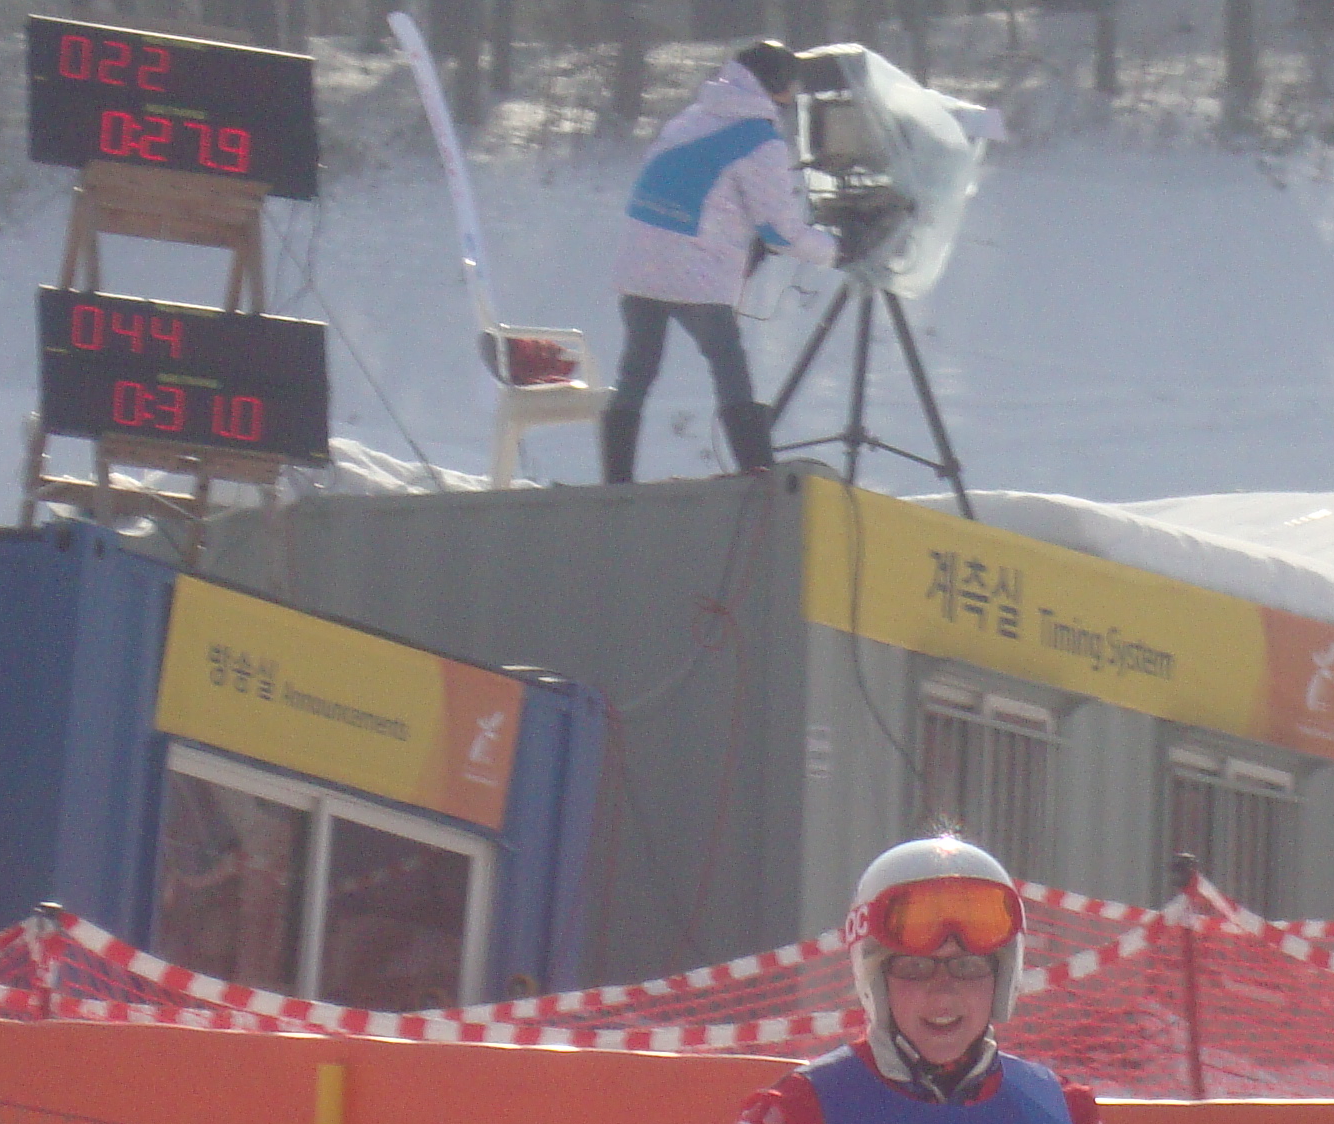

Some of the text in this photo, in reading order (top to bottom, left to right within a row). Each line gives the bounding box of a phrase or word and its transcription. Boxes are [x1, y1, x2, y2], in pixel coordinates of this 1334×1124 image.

[58, 34, 171, 92] 022
[70, 304, 184, 359] 044
[925, 550, 1177, 681] 계측실 Timing System
